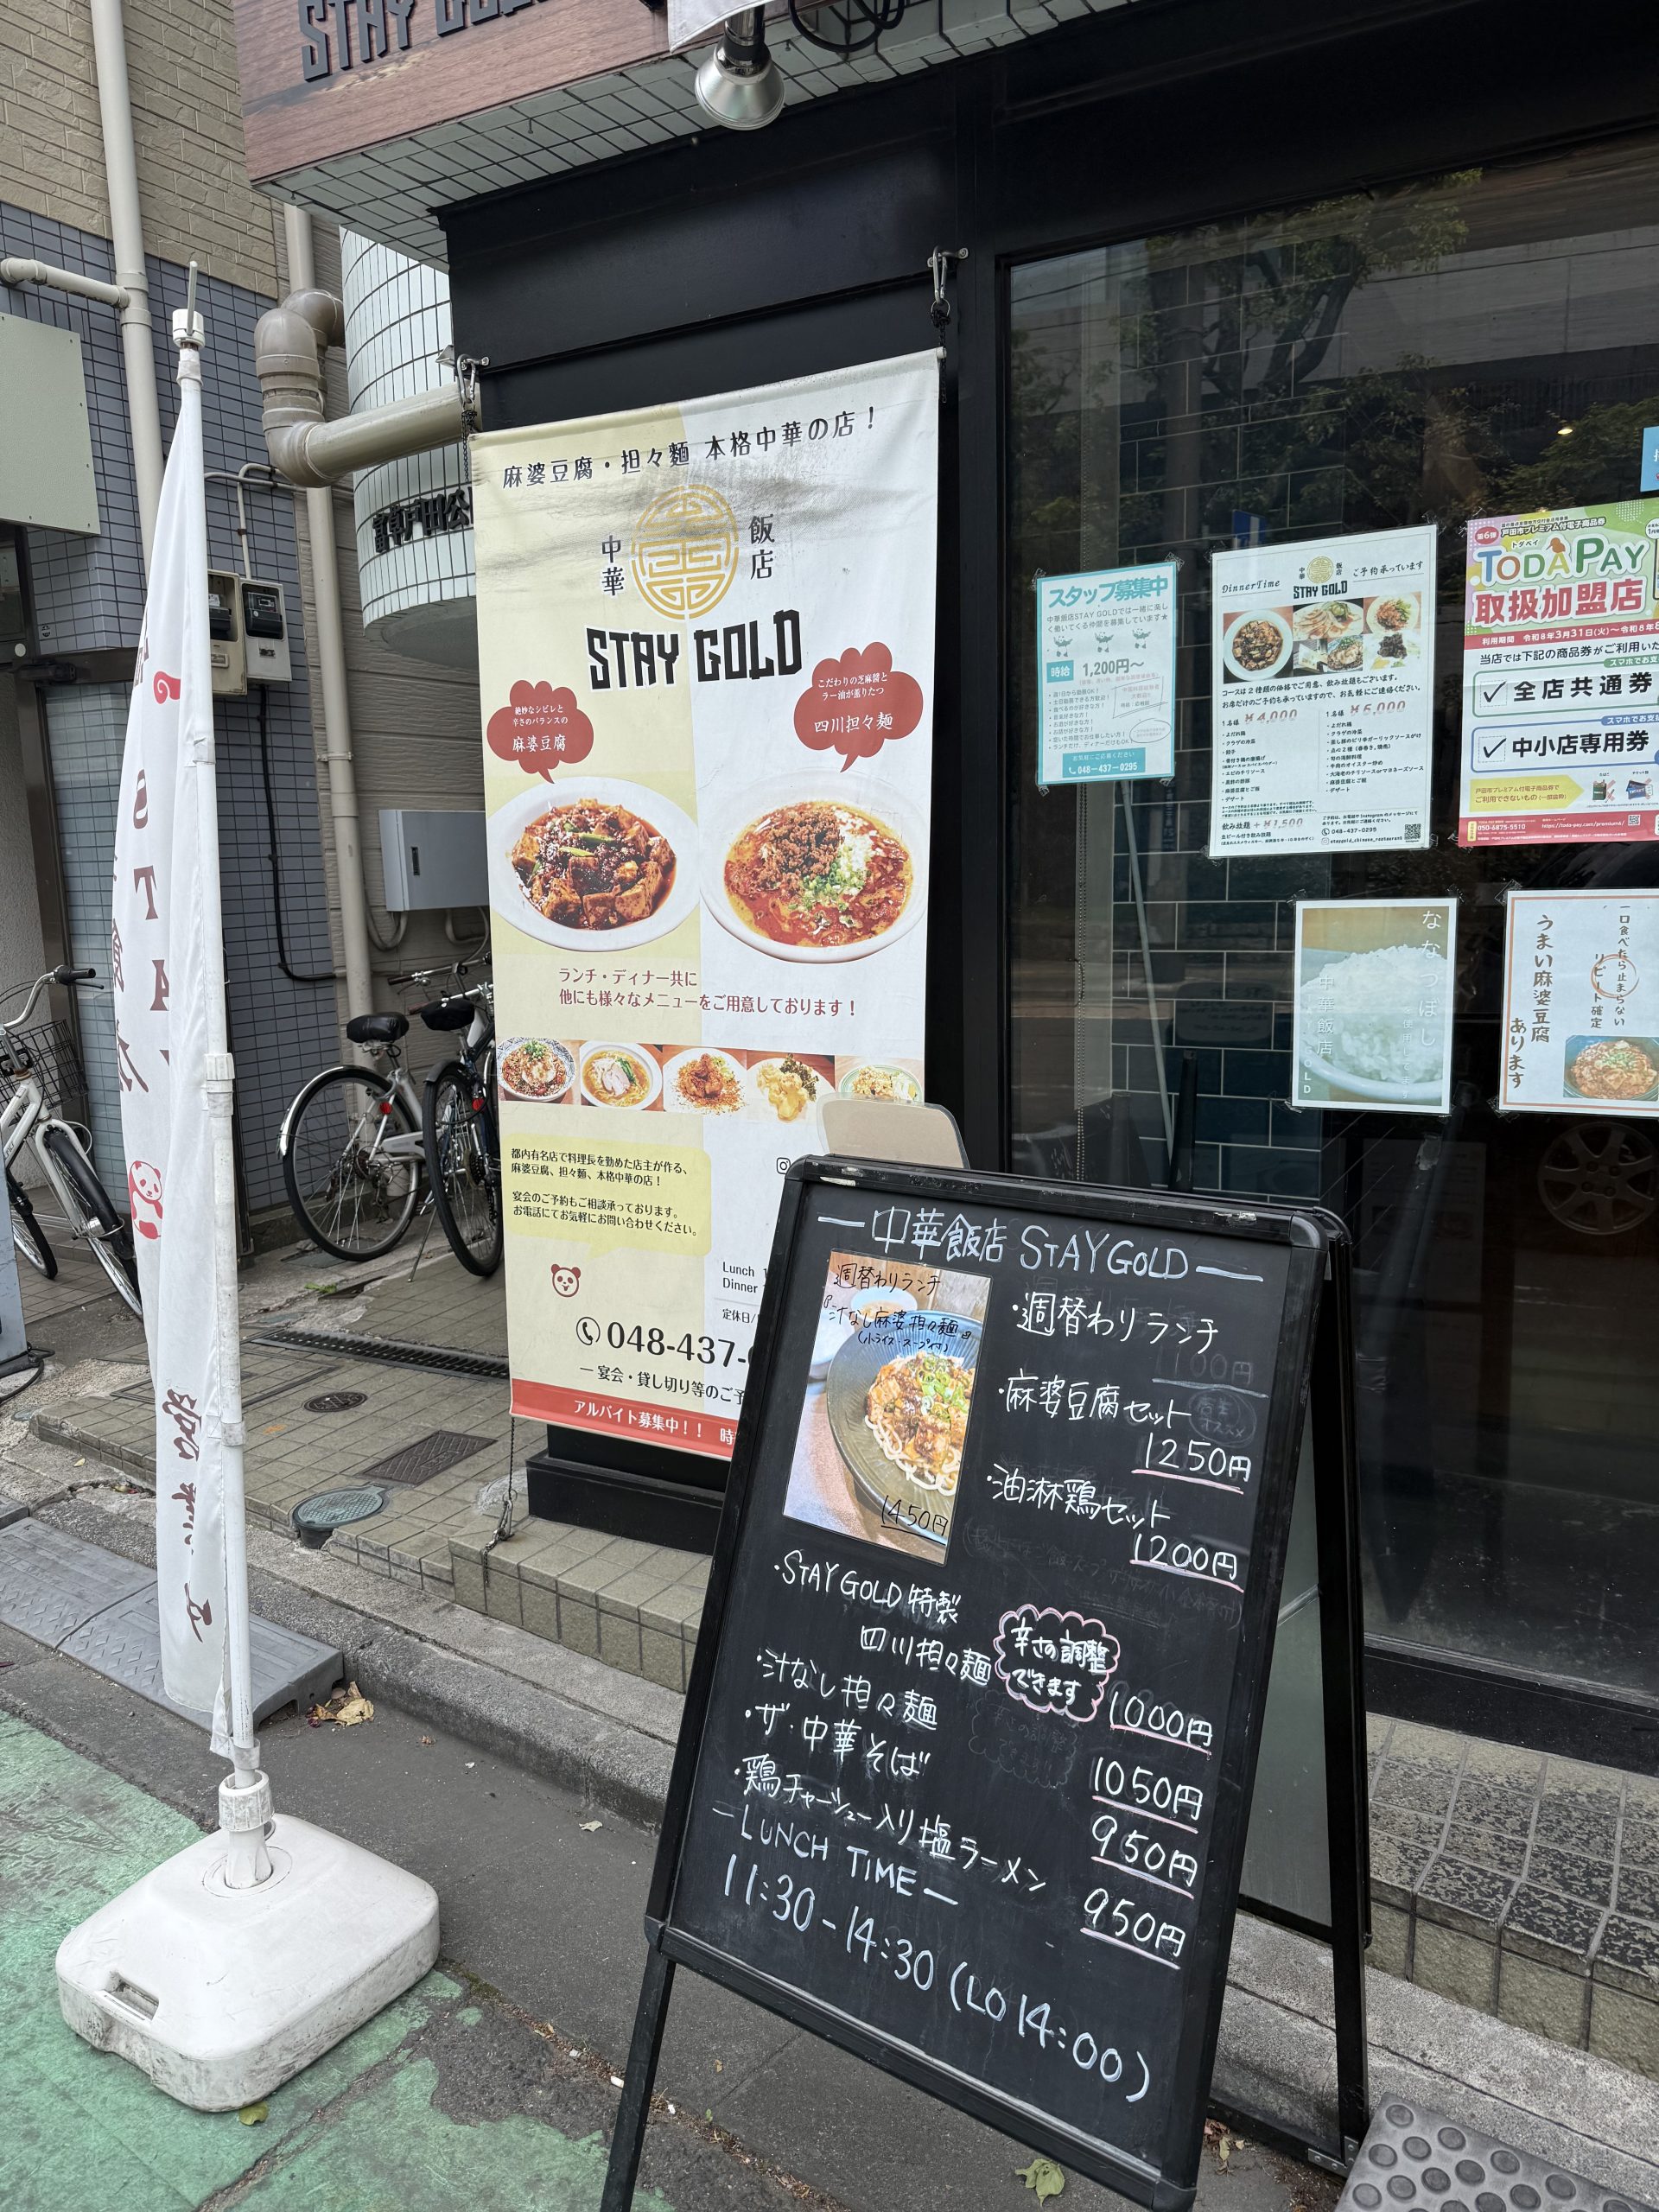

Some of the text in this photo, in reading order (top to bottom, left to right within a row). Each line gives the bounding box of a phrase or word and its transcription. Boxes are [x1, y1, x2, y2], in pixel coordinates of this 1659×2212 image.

[705, 406, 875, 461] 本格中華の店！
[1477, 531, 1497, 540] 第6弾
[1501, 517, 1606, 537] 戸田市プレミアム付電子商品券
[749, 514, 776, 580] 飯店
[1477, 537, 1645, 583] TODA PAY
[601, 535, 625, 596] 中華
[1299, 567, 1306, 580] 中華
[1336, 562, 1343, 576] 飯店
[1048, 575, 1168, 608] スタッフ募集中
[1293, 581, 1348, 600] STAY GOLD
[1474, 578, 1643, 625] 取扱加盟店
[587, 609, 803, 690] STAY GOLD
[1482, 636, 1515, 645] 利用期間
[1051, 666, 1070, 677] 時給
[1514, 671, 1653, 702] 全店共通券
[512, 716, 569, 727] 辛さのバランスの
[515, 704, 563, 715] 絶妙なシビレと
[512, 734, 567, 752] 麻婆豆腐
[1512, 730, 1649, 758] 中小店専用券
[559, 967, 697, 987] ランチ・ディナー共に
[1418, 910, 1442, 1047] ななつぼし
[1530, 914, 1554, 1044] うまい麻婆豆腐
[1591, 953, 1606, 1028] リピート確定
[559, 988, 856, 1017] 他にも様々なメニューをご用意しております！
[1318, 976, 1335, 1055] 中華飯店
[1508, 1017, 1527, 1090] あります
[512, 1191, 677, 1219] 宴会のご予約もご相談承っております。
[513, 1205, 696, 1236] お電話にてお気軽にお問い合わせください。
[871, 1207, 1007, 1263] 中華飯店
[722, 1262, 755, 1277] Lunch
[722, 1277, 759, 1294] Dinner
[834, 1262, 940, 1295] 週替わりランチ
[722, 1308, 760, 1324] 定休日/
[720, 1427, 737, 1446] 時
[1145, 1432, 1252, 1483] 1250円
[880, 1495, 949, 1537] 1450円
[1134, 1535, 1238, 1580] 1200円
[1011, 1618, 1109, 1675] 辛さの調整
[1012, 1669, 1082, 1705] できます
[1109, 1691, 1213, 1747] 1000円
[1092, 1757, 1203, 1820] 1050円
[741, 1803, 830, 1863] LUNCH
[1092, 1815, 1198, 1888] 950円
[1084, 1889, 1186, 1958] 950円
